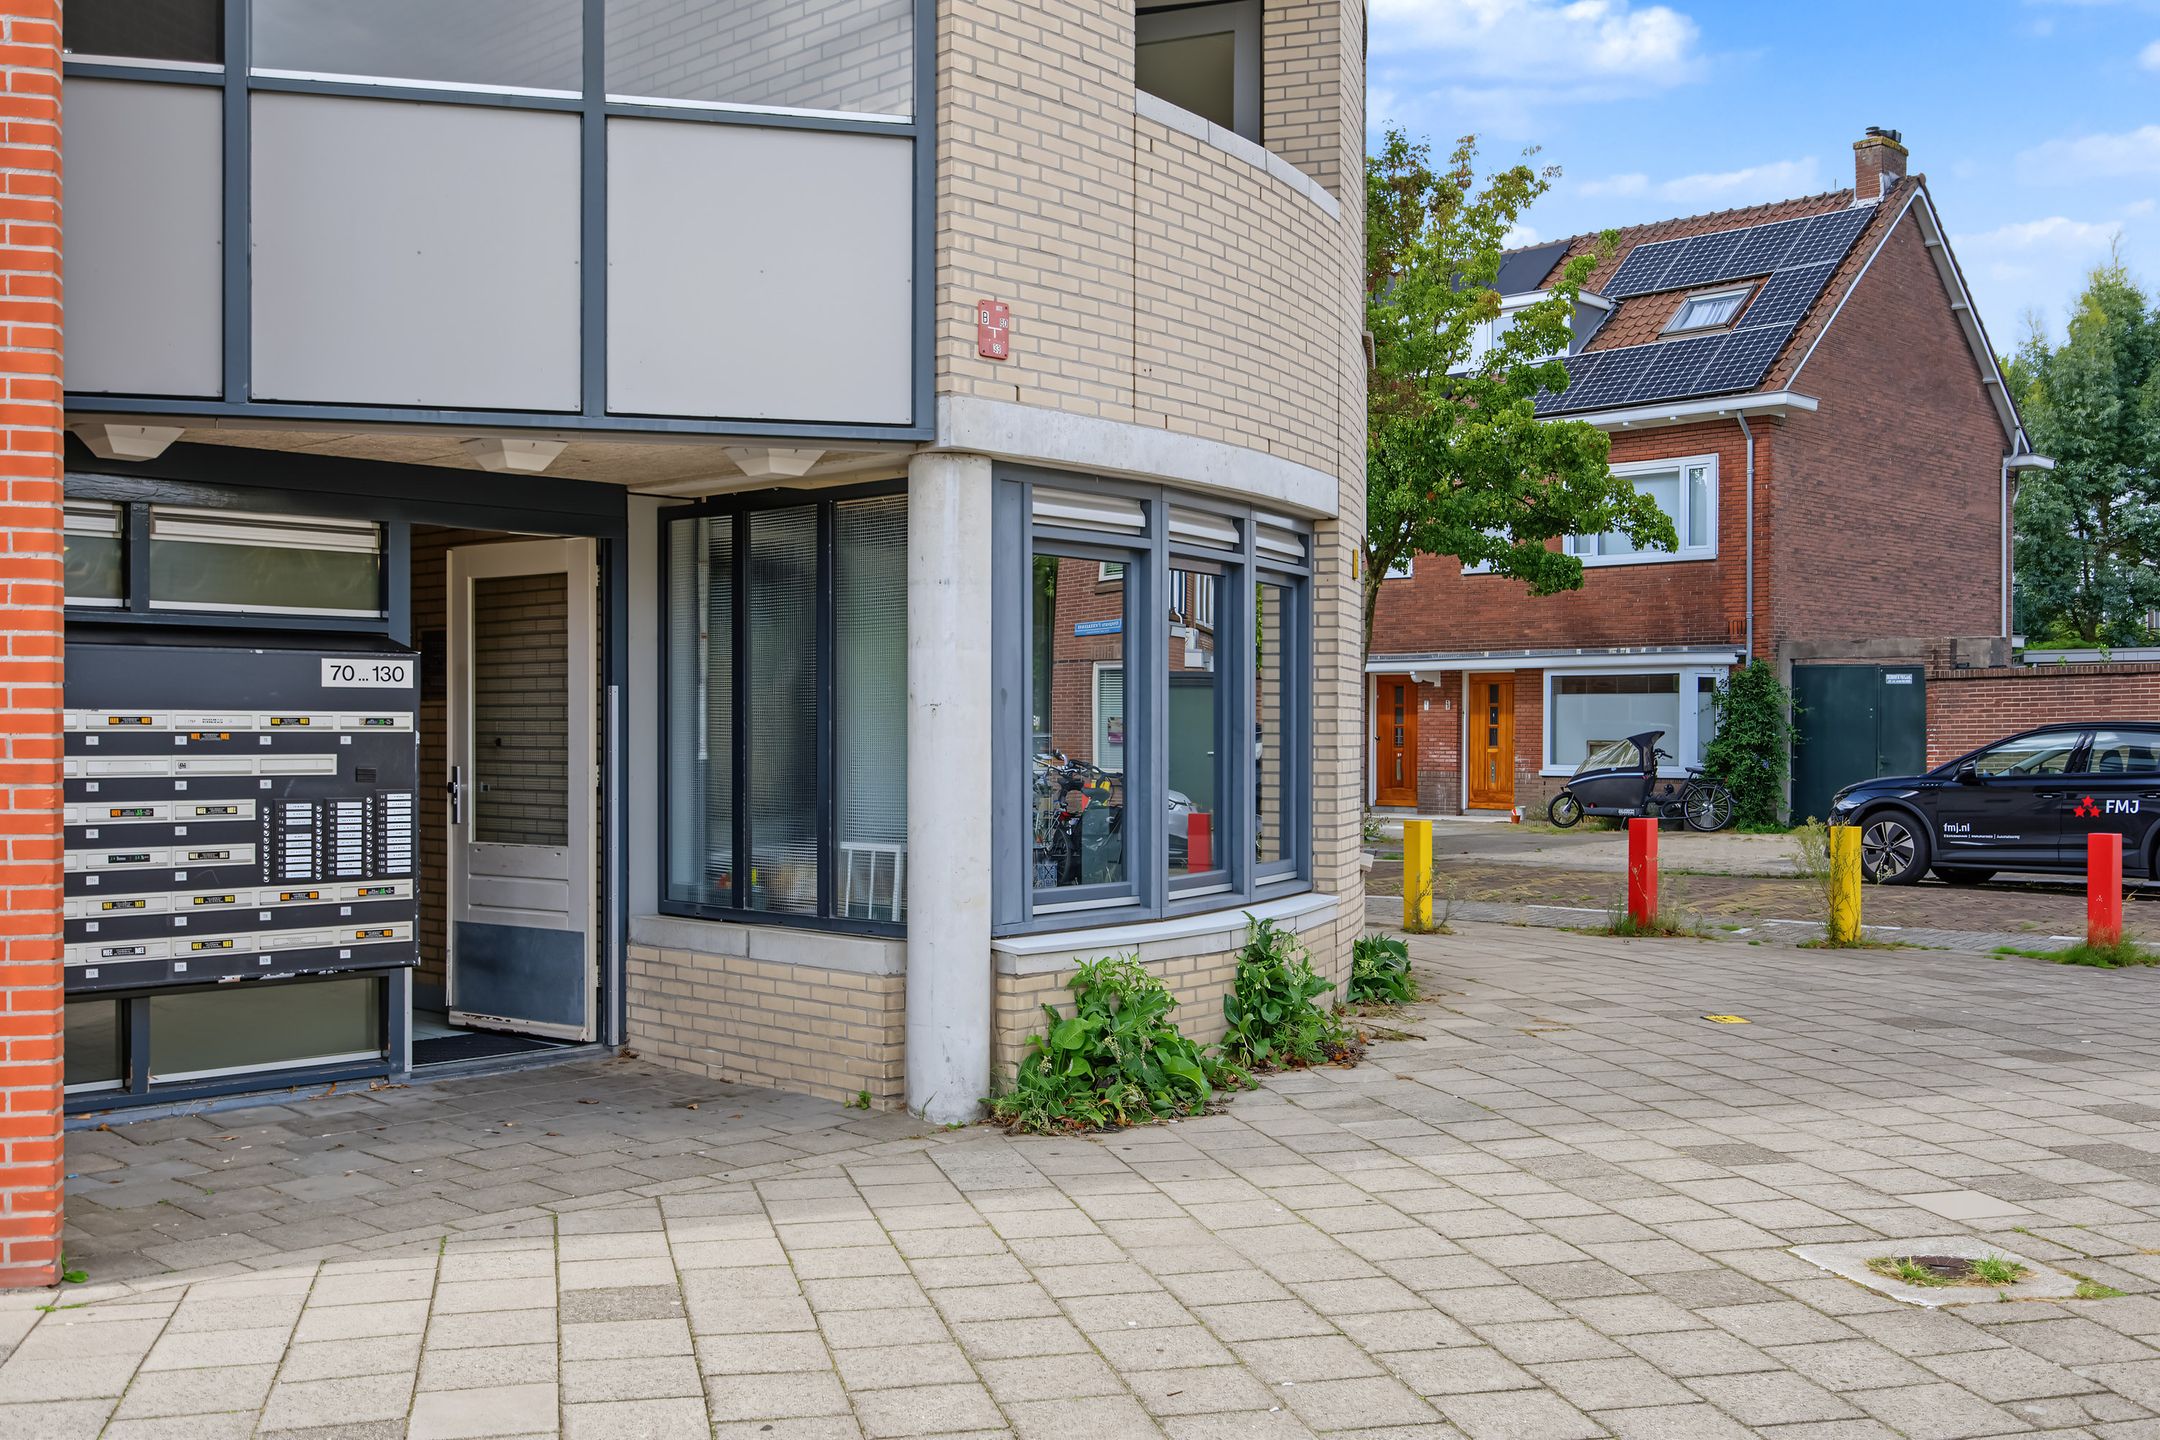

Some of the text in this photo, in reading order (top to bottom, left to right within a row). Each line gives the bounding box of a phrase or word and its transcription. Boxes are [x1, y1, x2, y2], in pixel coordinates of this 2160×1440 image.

[982, 311, 988, 324] B
[2105, 799, 2140, 814] FMJ
[1943, 823, 1970, 833] fmj.nl
